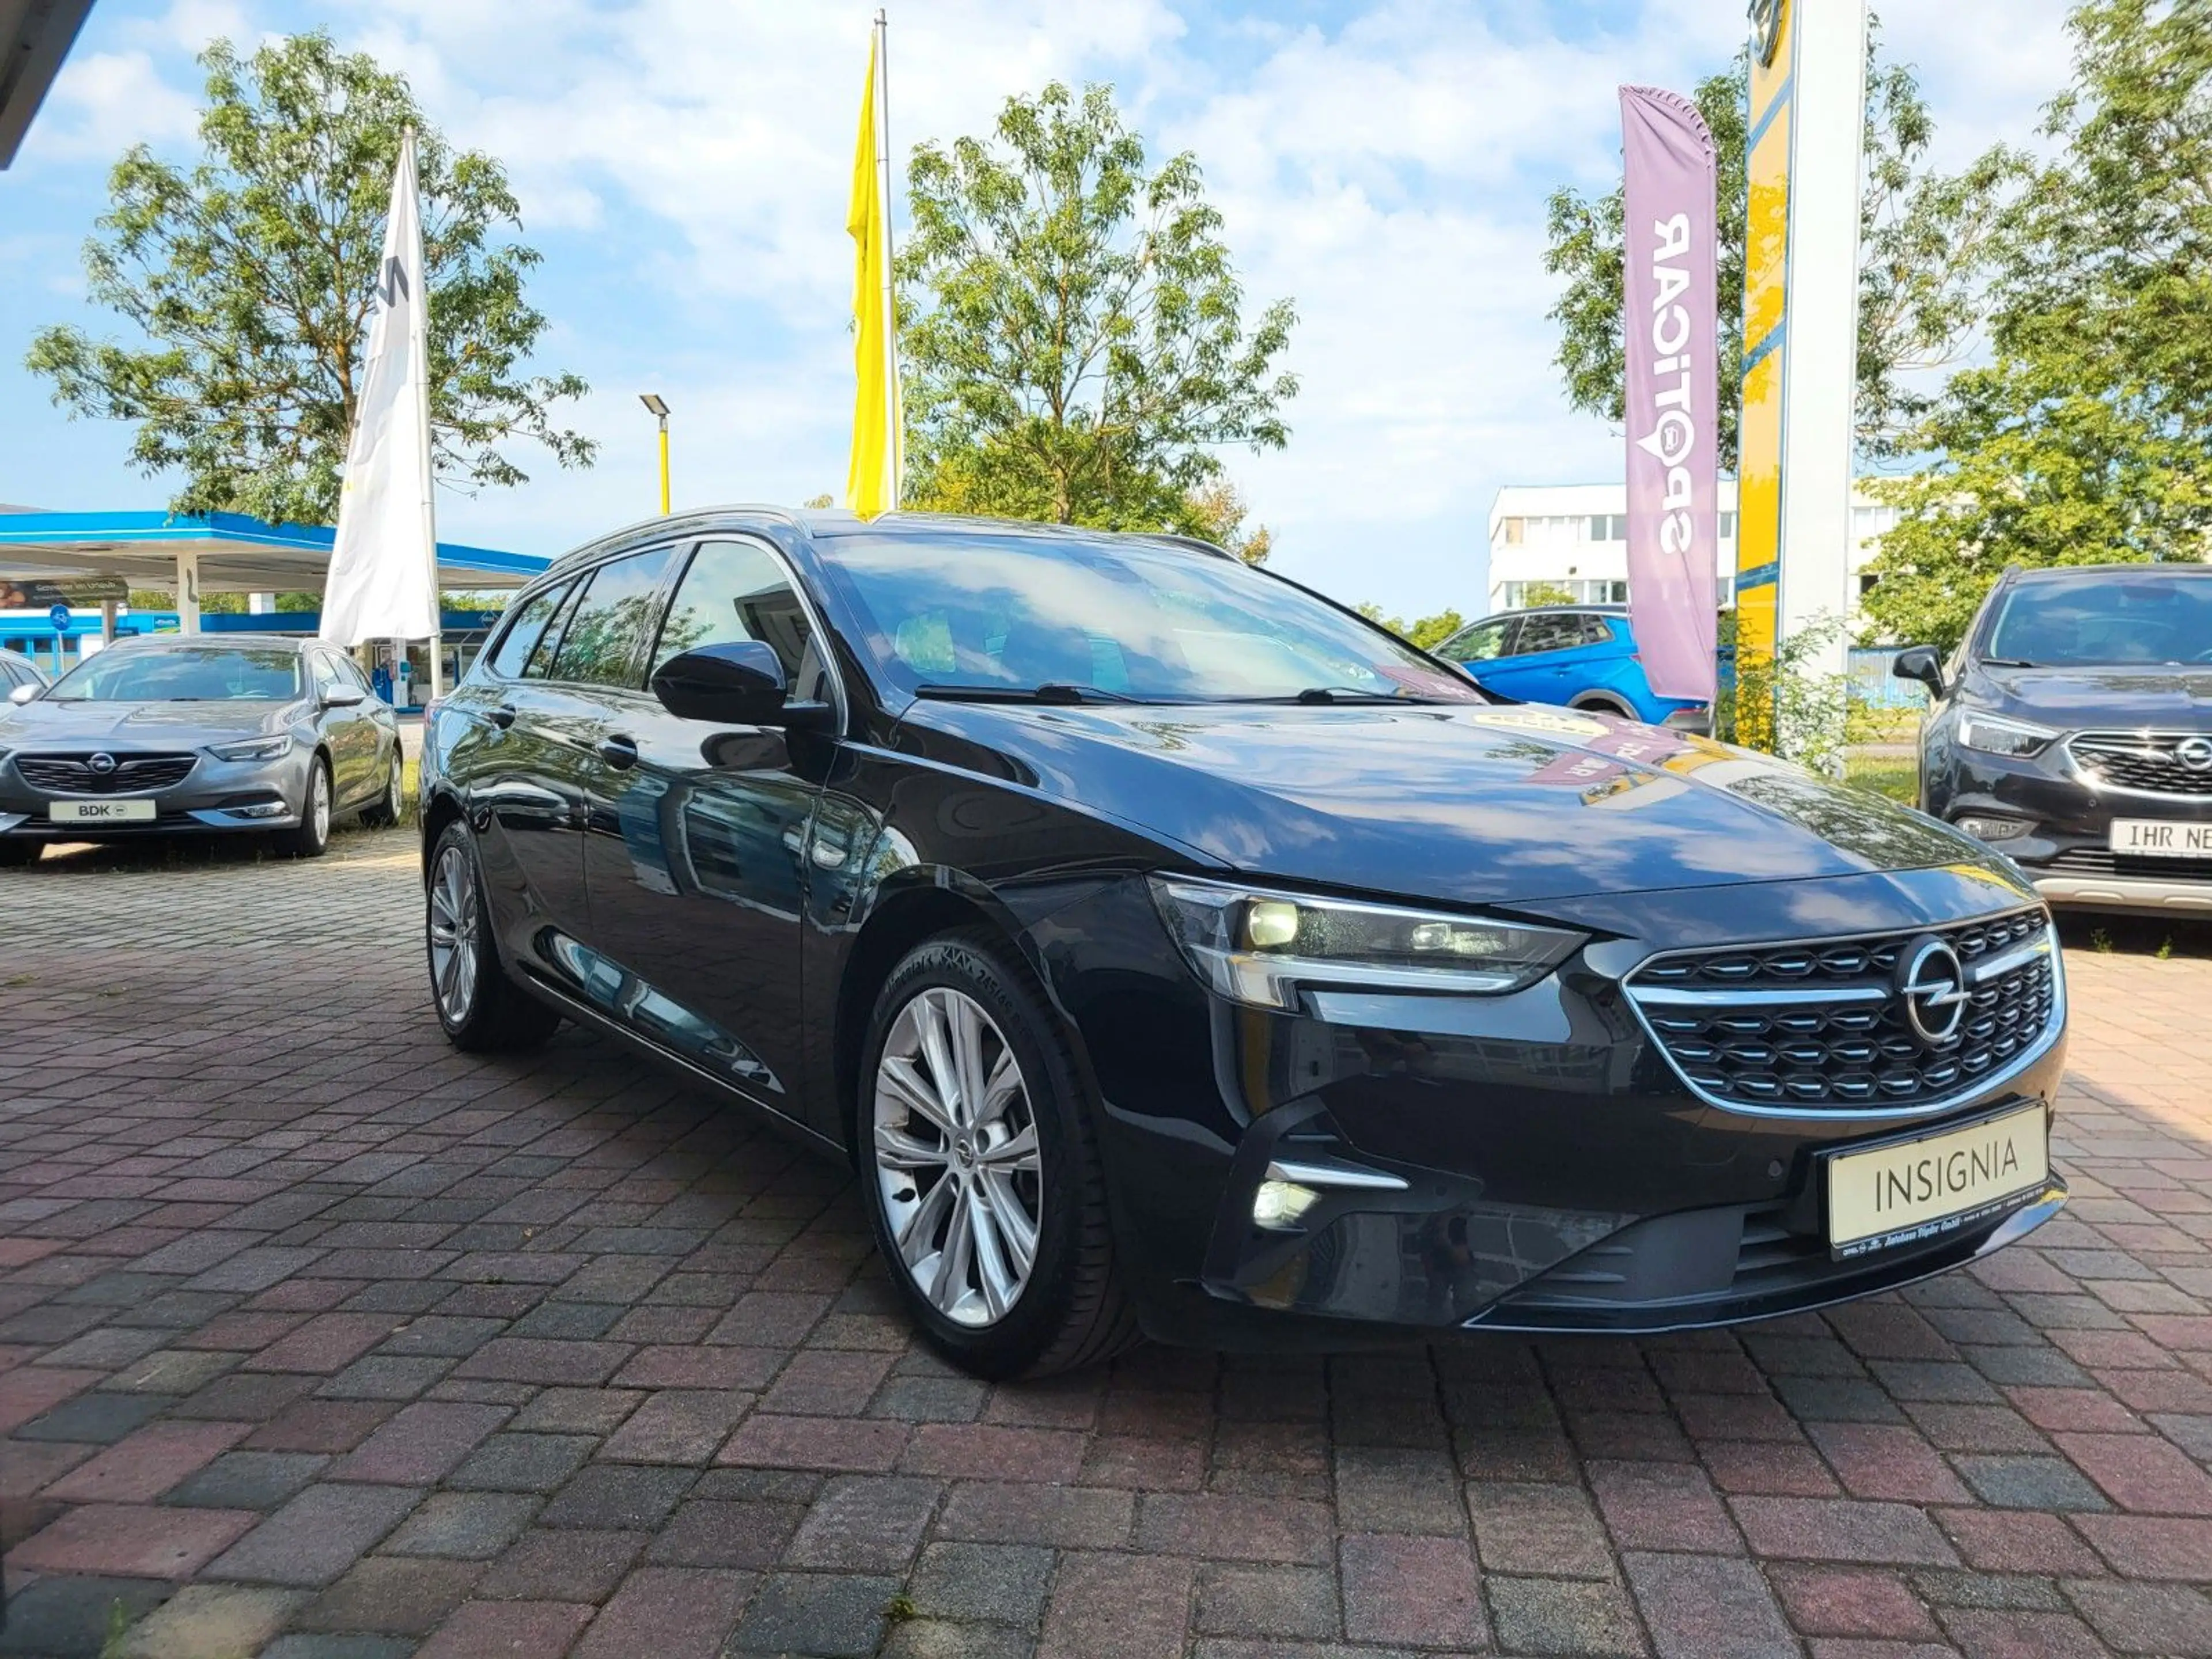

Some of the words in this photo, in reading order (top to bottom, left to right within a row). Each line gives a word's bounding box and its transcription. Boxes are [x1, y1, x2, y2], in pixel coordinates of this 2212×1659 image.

[78, 805, 110, 817] BDK
[2129, 825, 2173, 848] IHR
[1876, 1137, 2019, 1212] INSIGNIA
